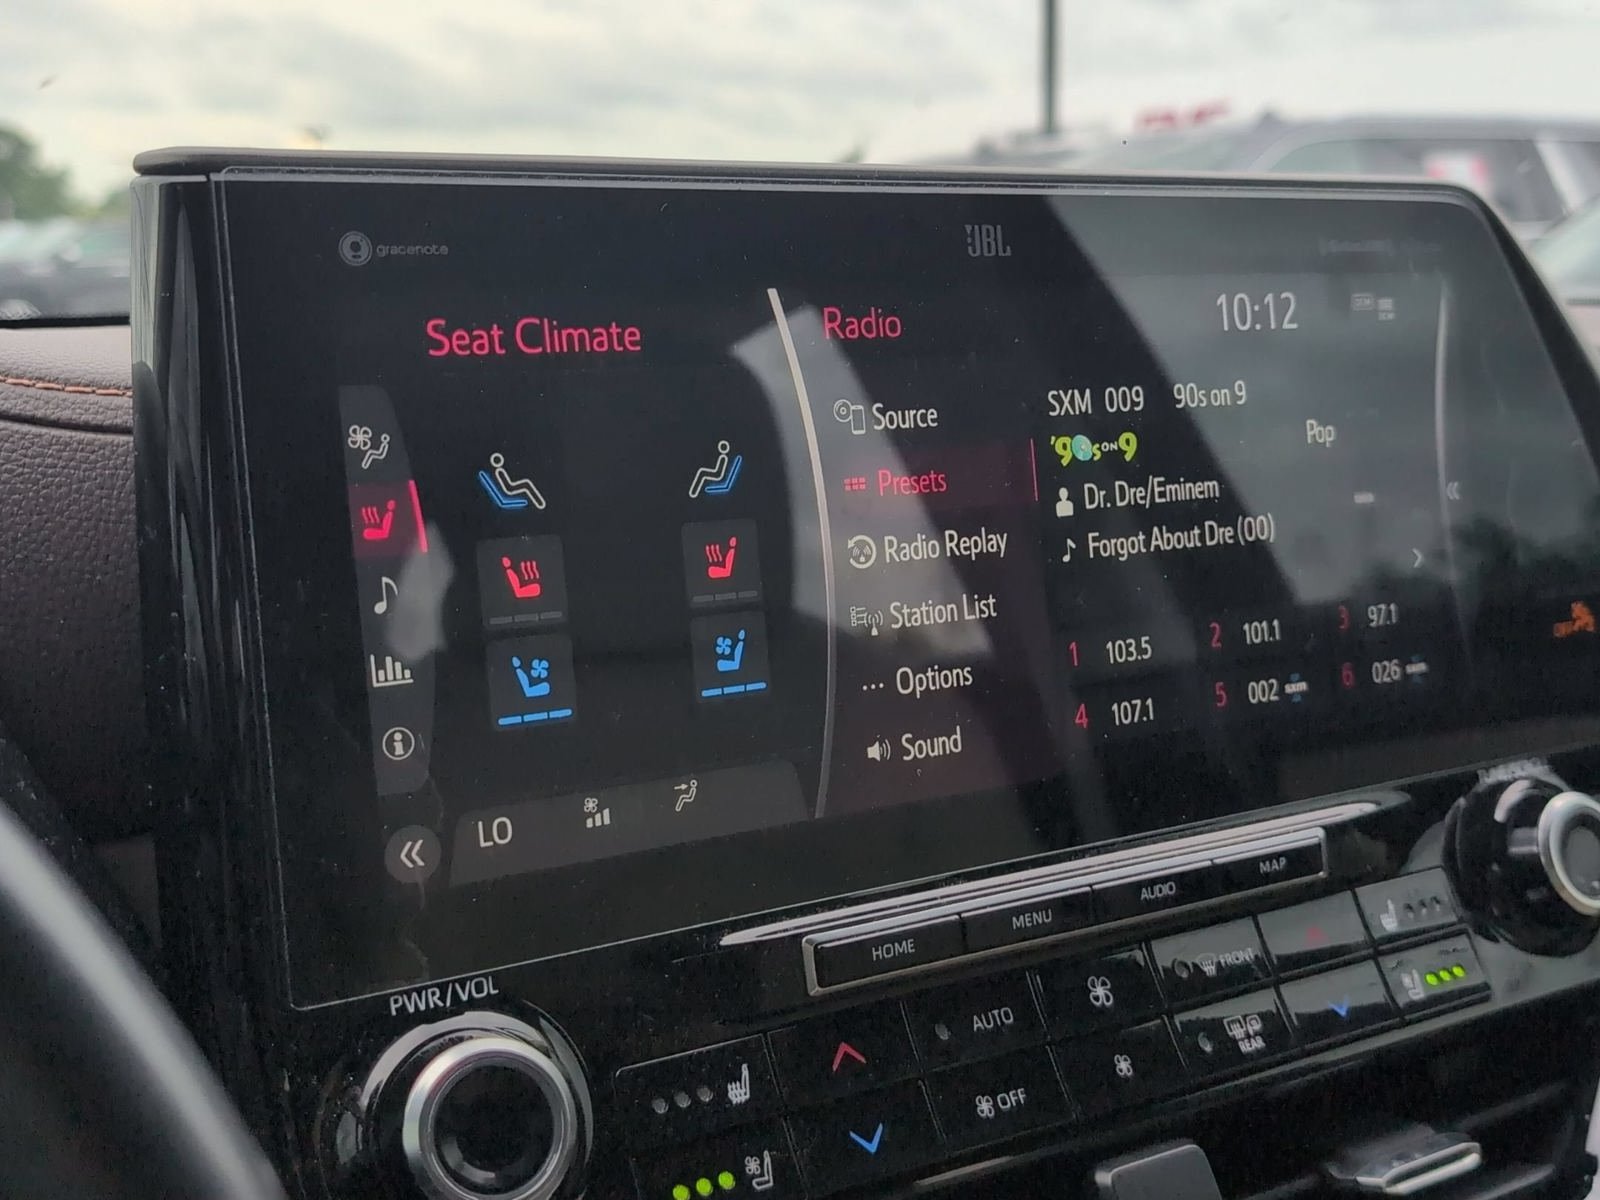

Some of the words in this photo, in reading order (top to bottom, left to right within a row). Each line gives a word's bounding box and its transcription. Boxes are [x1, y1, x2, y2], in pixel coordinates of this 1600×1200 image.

[964, 224, 1012, 257] JBL
[824, 306, 902, 339] Radio
[1216, 291, 1299, 333] 10:12
[425, 318, 506, 358] Seat
[514, 316, 642, 354] Climate
[1047, 388, 1092, 416] SXM
[1104, 386, 1144, 412] 009
[1173, 382, 1207, 408] 90s
[1210, 388, 1230, 406] on
[1234, 380, 1247, 405] 9
[872, 402, 939, 431] Source
[1306, 419, 1336, 448] Pop
[878, 468, 948, 497] Presets
[1084, 482, 1111, 510] Dr.
[1115, 475, 1220, 509] Dre/Eminem
[884, 532, 940, 564] Radio
[945, 526, 1008, 561] Replay
[1088, 531, 1146, 561] Forgot
[1150, 524, 1202, 552] About
[1204, 520, 1235, 546] Dre
[1237, 512, 1276, 545] (00)
[890, 599, 958, 629] Station
[962, 593, 998, 621] List
[1338, 605, 1349, 629] 3
[1367, 602, 1398, 628] 97.1
[1209, 622, 1223, 648] 2
[1242, 618, 1281, 645] 101.1
[1068, 640, 1080, 666] 1
[1105, 636, 1152, 664] 103.5
[896, 664, 973, 699] Options
[1342, 662, 1354, 686] 6
[1371, 658, 1401, 684] 026
[1214, 681, 1227, 707] 5
[1248, 678, 1280, 704] 002
[1074, 703, 1088, 729] 4
[1111, 697, 1155, 727] 107.1
[901, 725, 963, 761] Sound
[477, 816, 513, 849] LO
[1259, 857, 1287, 874] MAP
[1140, 881, 1177, 901] AUDIO
[1011, 909, 1053, 930] MENU
[871, 938, 916, 961] HOME
[1219, 949, 1257, 967] FRONT
[389, 975, 500, 1017] PWR/VOL
[972, 1007, 1014, 1032] AUTO
[1238, 1036, 1266, 1054] REAR
[997, 1088, 1027, 1111] OFF
